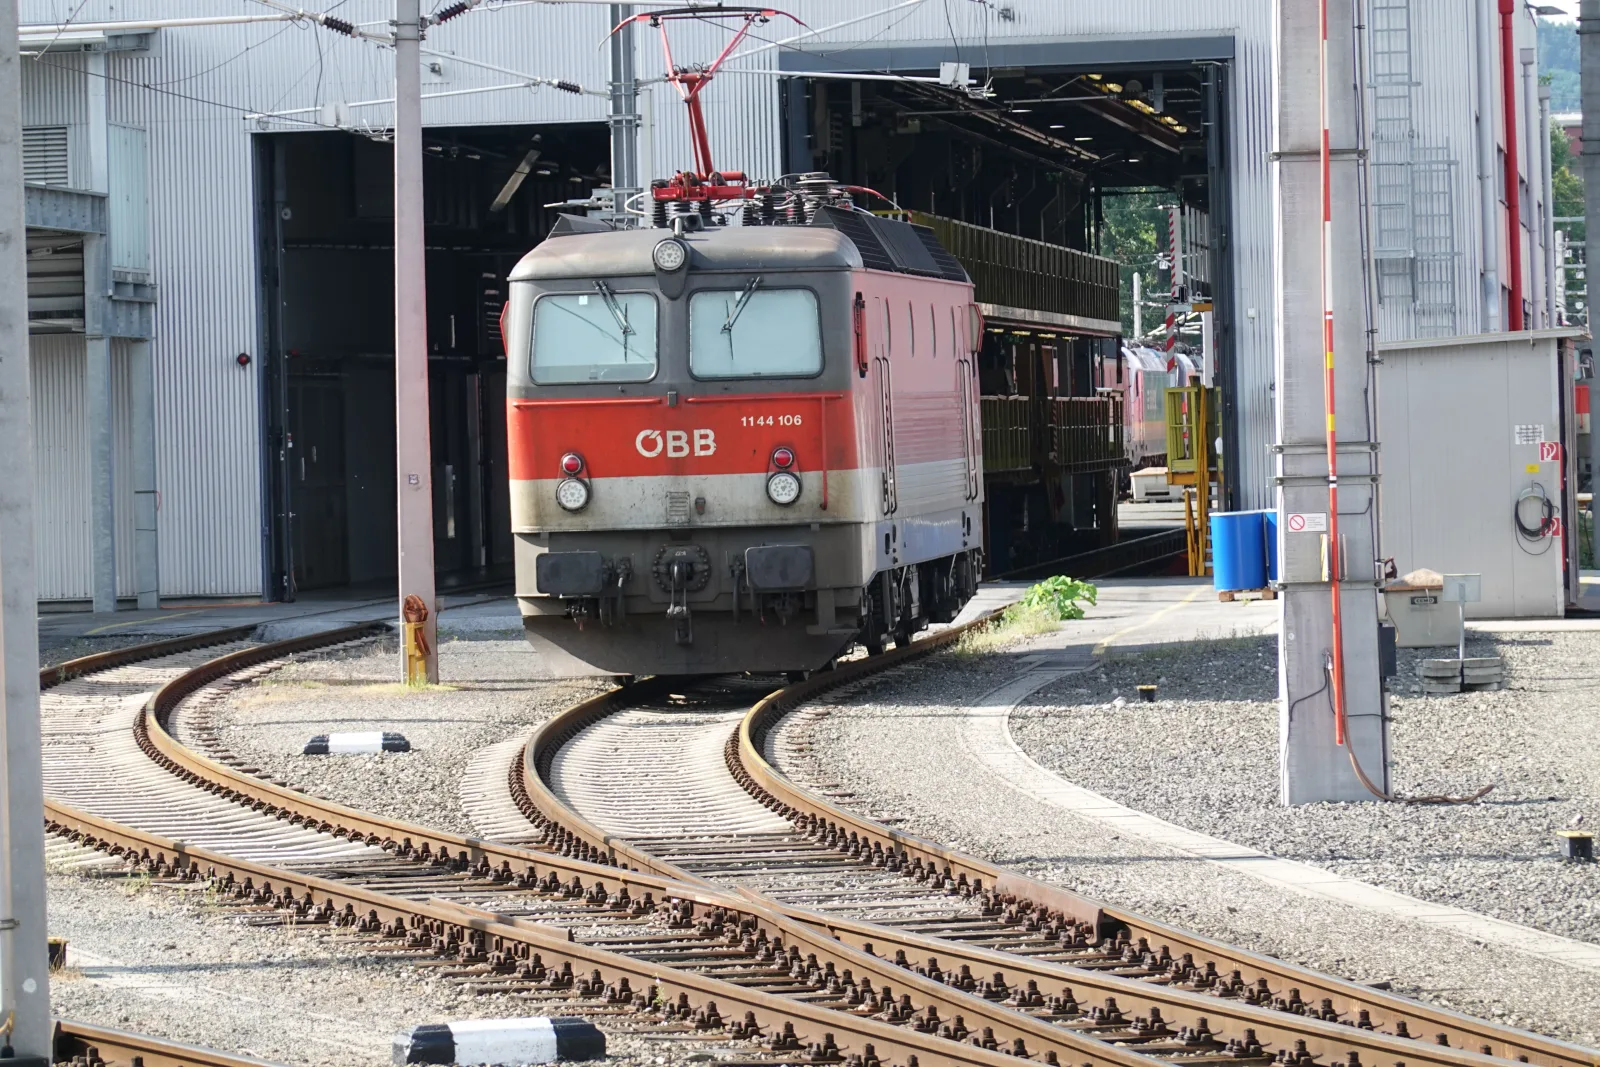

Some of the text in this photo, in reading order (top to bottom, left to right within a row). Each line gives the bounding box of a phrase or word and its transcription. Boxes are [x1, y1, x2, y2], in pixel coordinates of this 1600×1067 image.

[741, 415, 802, 427] 1144 106
[635, 428, 717, 458] ÖBB
